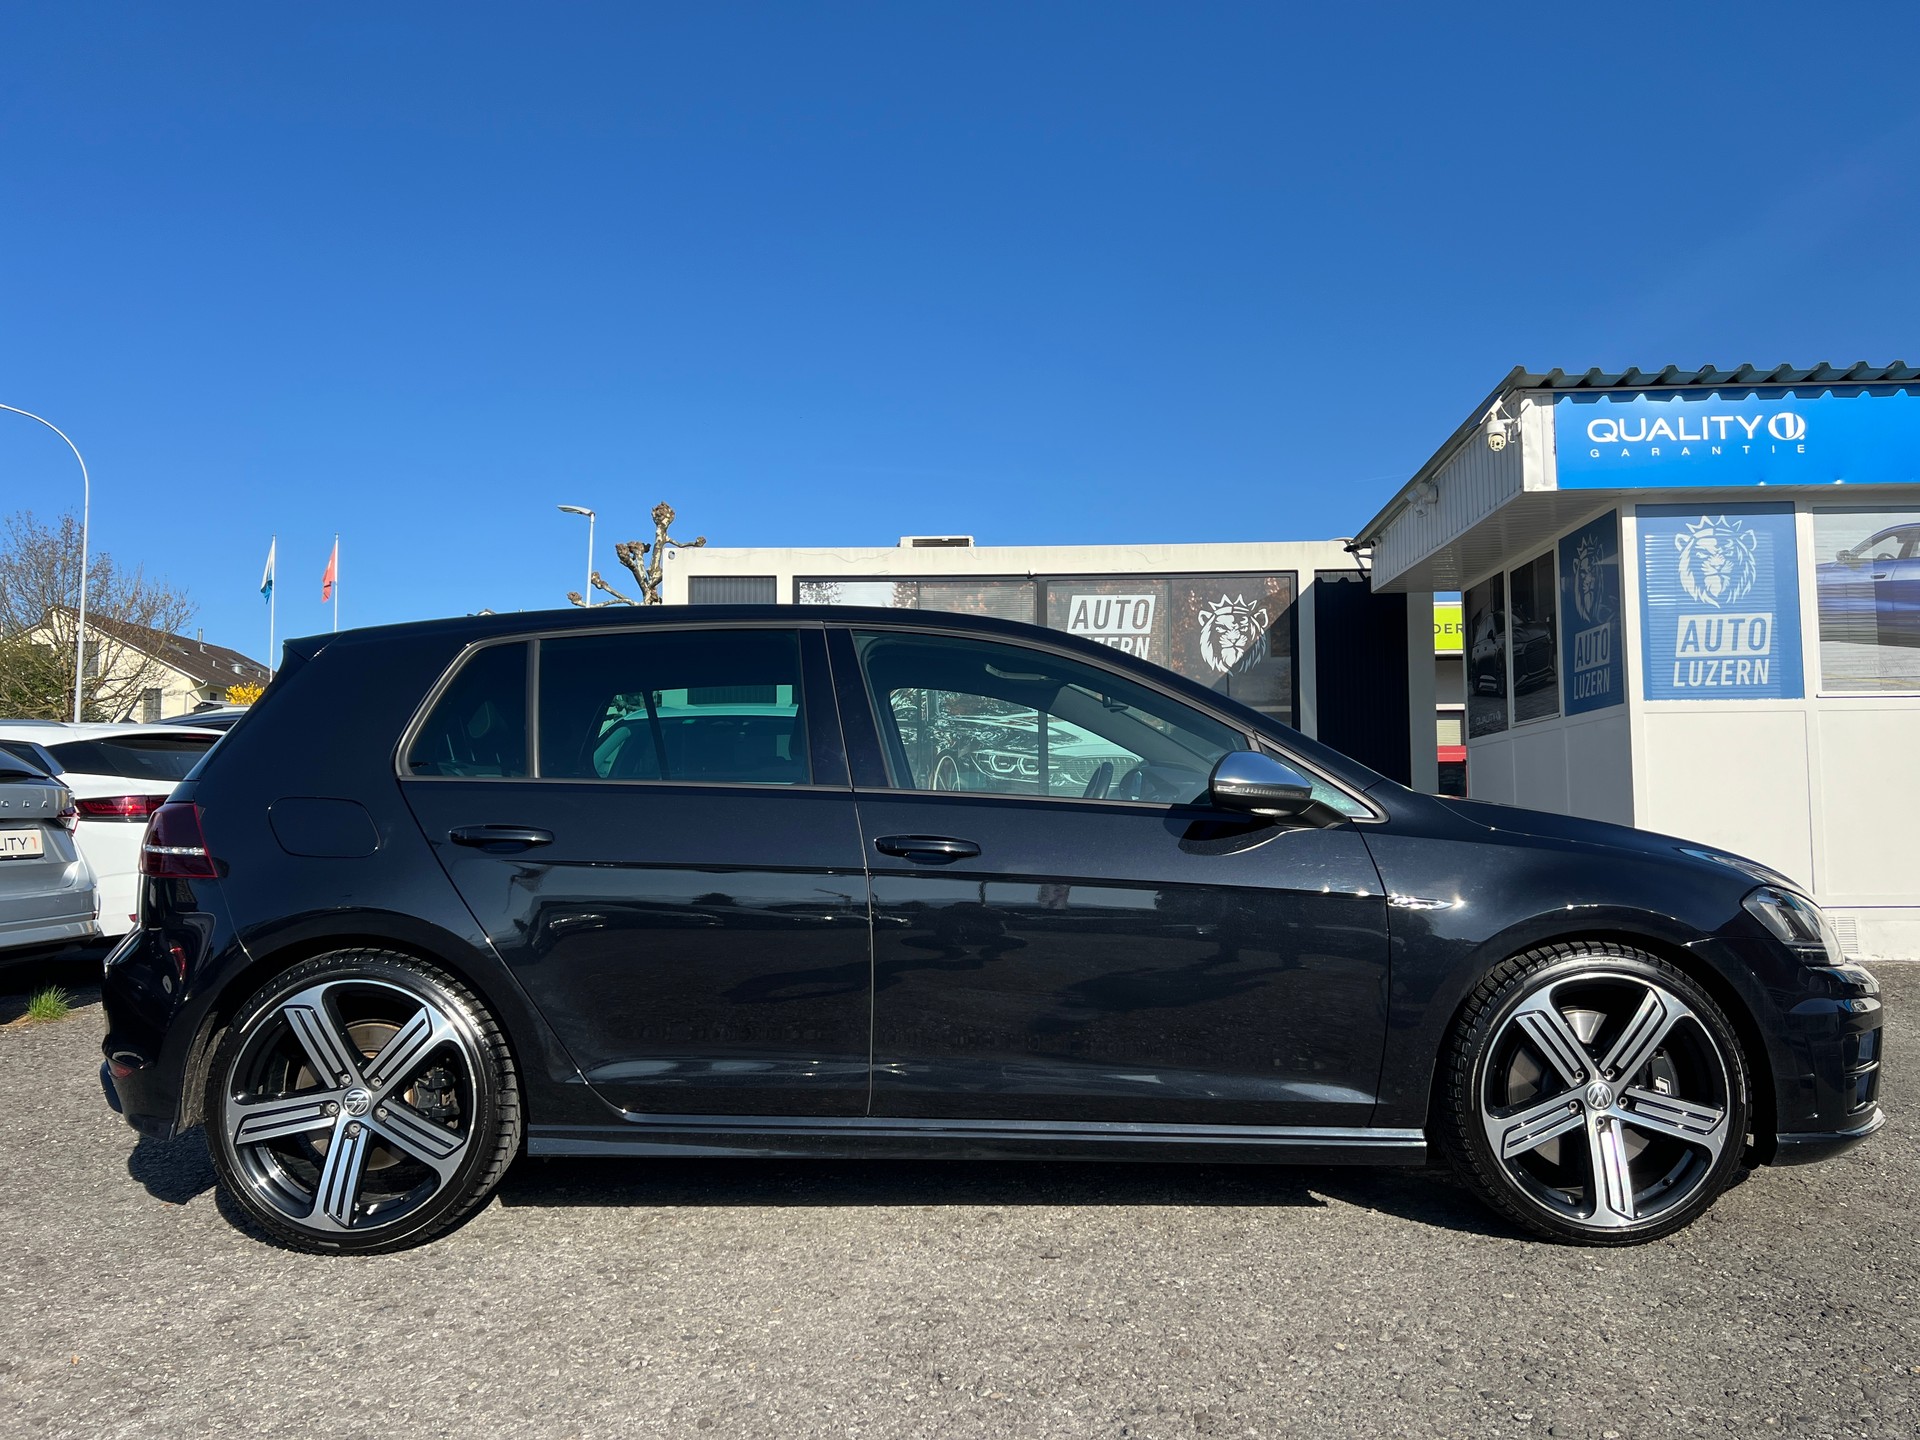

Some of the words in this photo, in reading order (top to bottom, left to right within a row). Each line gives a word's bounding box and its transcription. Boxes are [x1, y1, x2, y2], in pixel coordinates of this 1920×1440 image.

[1587, 415, 1763, 442] QUALITY
[1590, 444, 1805, 458] GARANTIE
[1071, 598, 1150, 630] AUTO
[1575, 627, 1609, 669] AUTO
[1680, 617, 1767, 653] AUTO
[1573, 667, 1611, 700] LUZERN
[1673, 658, 1770, 687] LUZERN
[31, 836, 37, 850] 1
